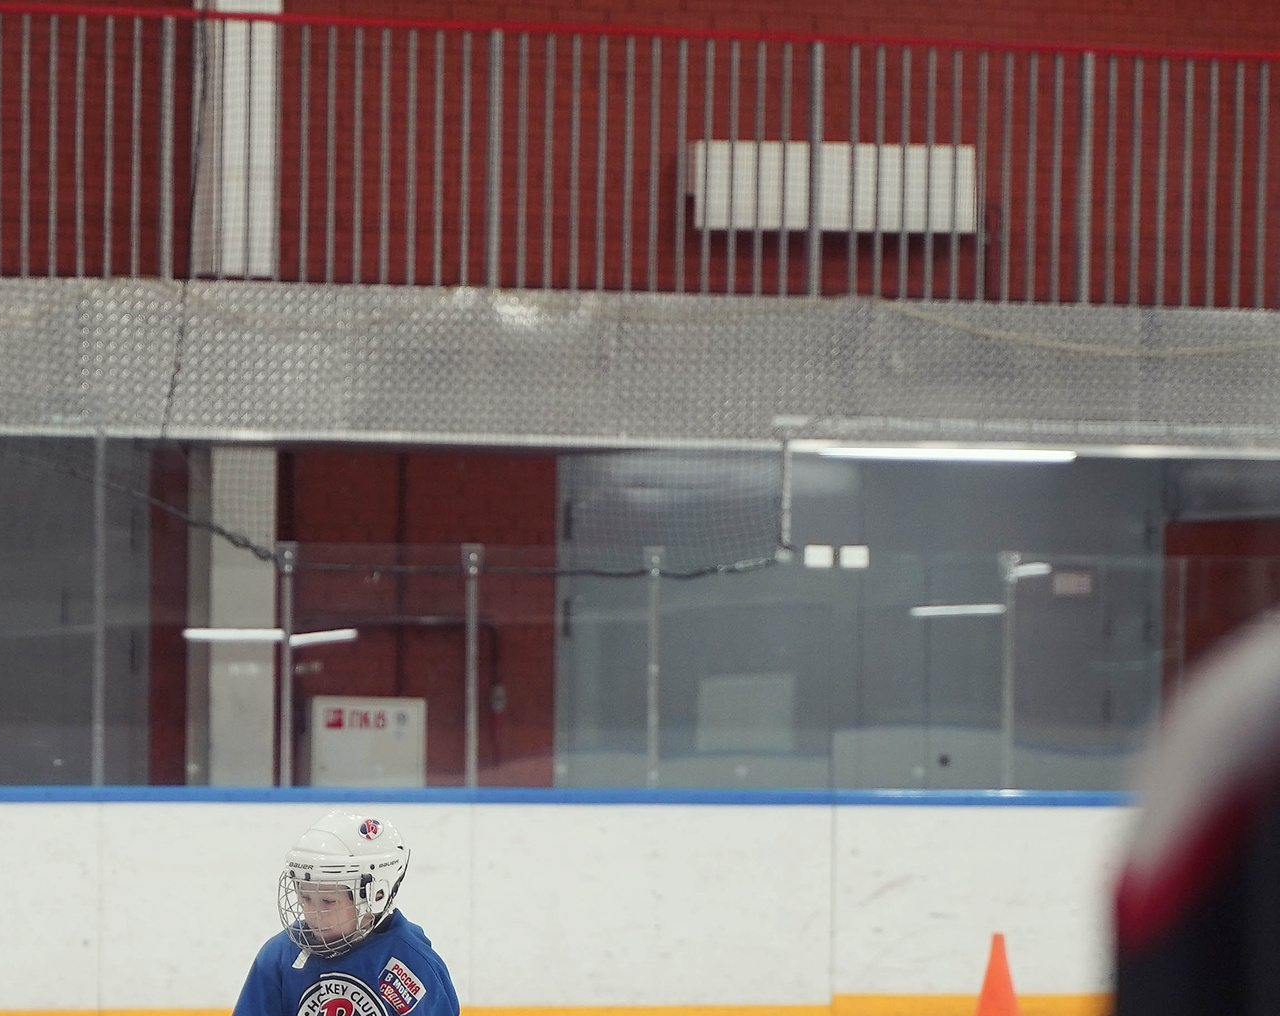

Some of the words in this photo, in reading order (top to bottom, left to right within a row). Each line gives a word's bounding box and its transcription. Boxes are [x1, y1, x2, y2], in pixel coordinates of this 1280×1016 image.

[288, 861, 314, 871] BAUER
[378, 859, 400, 868] BAUER
[392, 963, 421, 996] РОССИЯ
